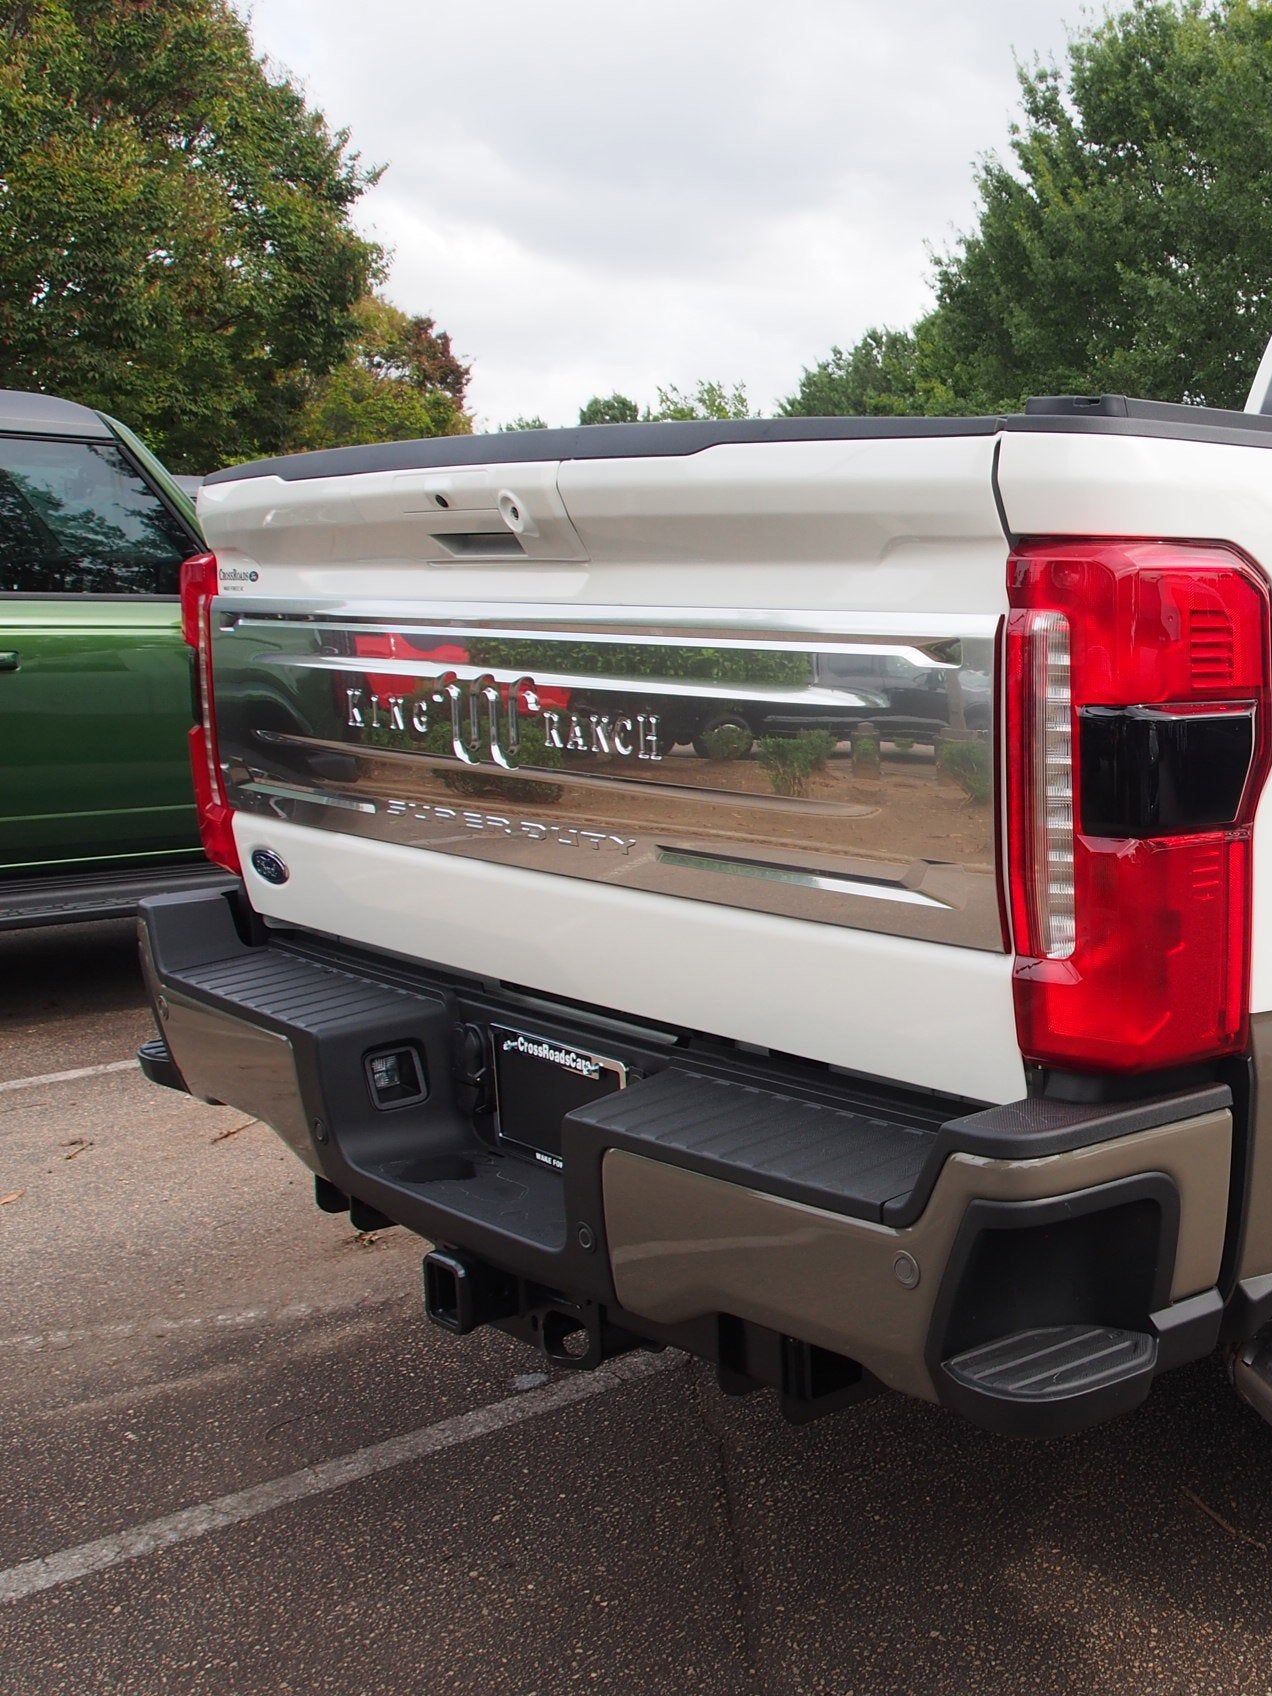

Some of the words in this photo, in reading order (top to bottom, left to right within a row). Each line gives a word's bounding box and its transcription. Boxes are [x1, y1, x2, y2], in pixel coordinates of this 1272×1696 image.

[346, 688, 428, 734] KING
[542, 711, 663, 761] RANCH
[387, 799, 511, 836] SUPER
[520, 821, 637, 856] DUTY
